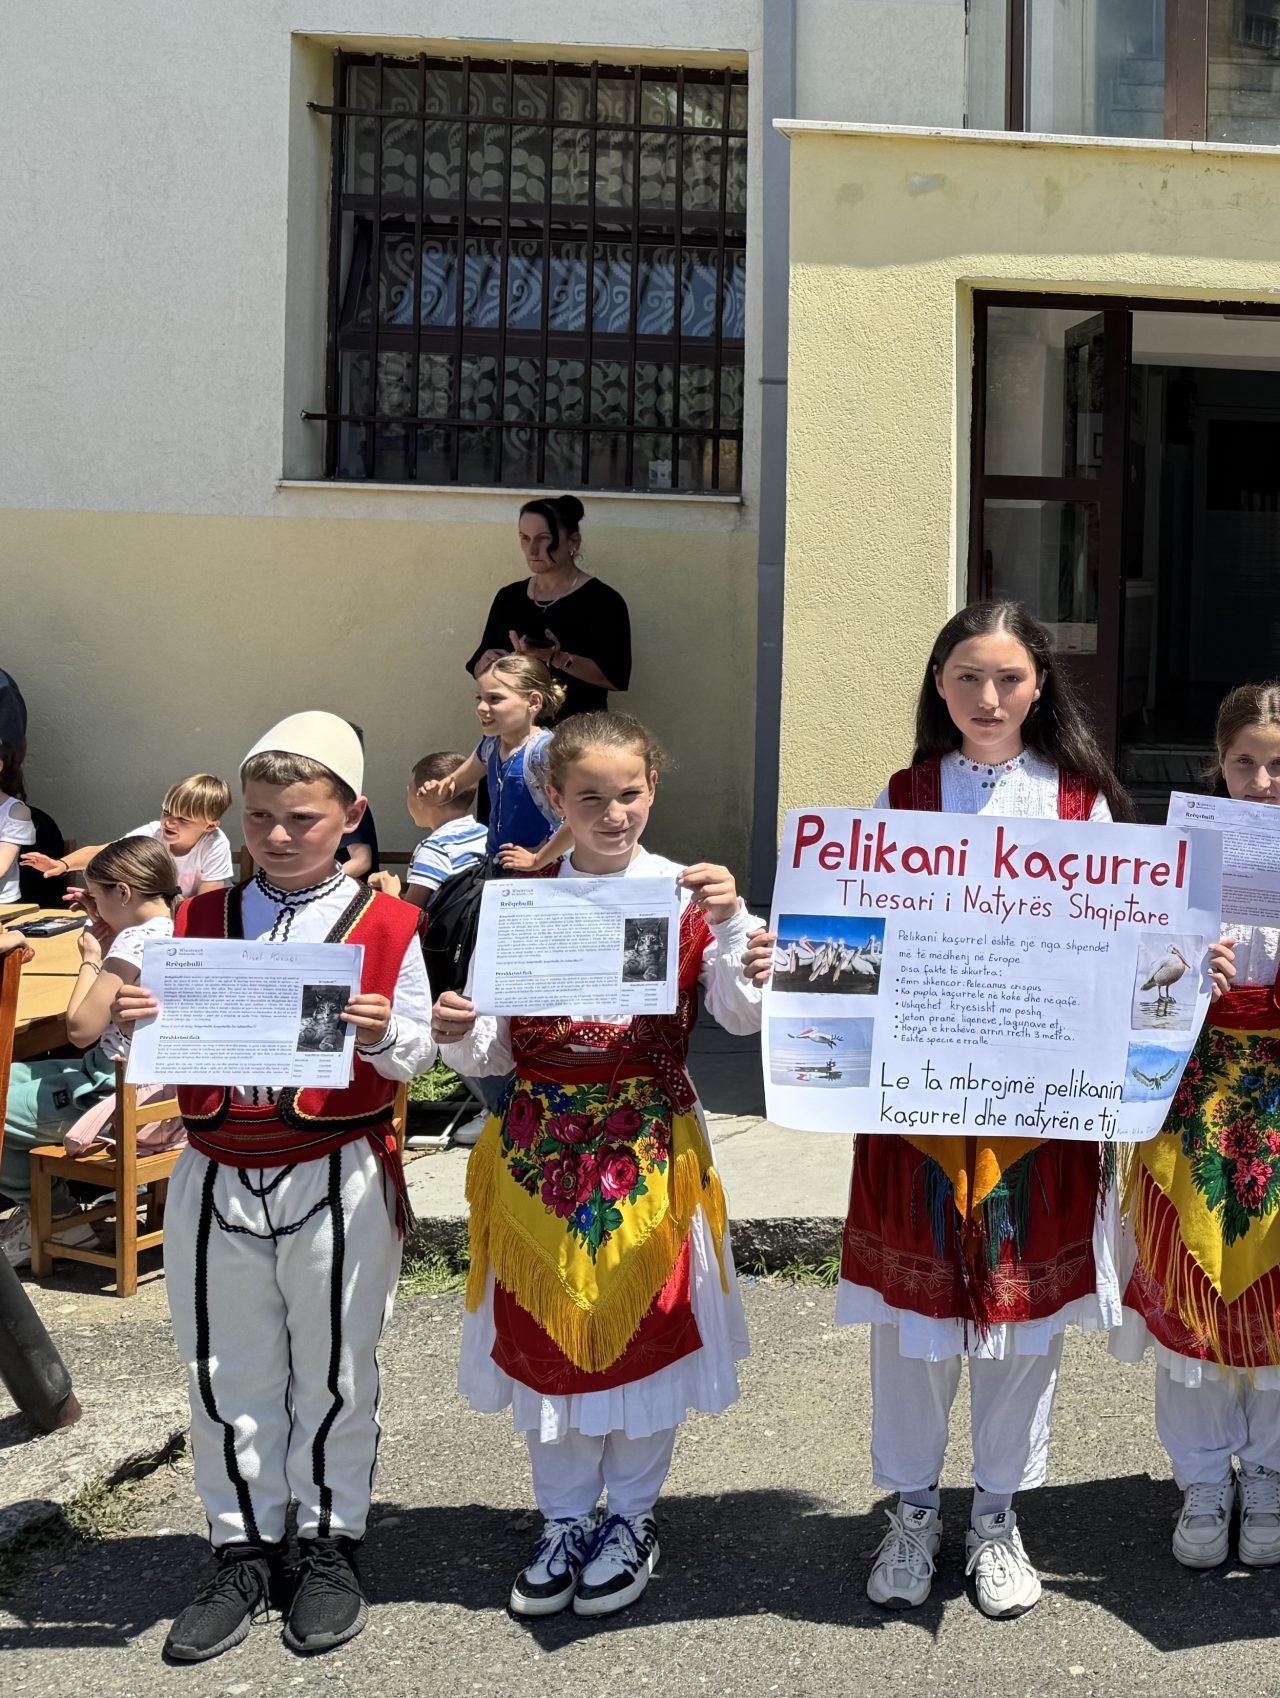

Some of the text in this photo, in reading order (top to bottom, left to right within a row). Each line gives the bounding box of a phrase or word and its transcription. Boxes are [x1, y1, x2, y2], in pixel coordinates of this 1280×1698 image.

[792, 814, 970, 877] Pelikani
[993, 825, 1188, 892] kaçurrel
[836, 878, 1170, 932] Thesari i Natyrës Shqiptare
[898, 929, 938, 943] Pelikani
[942, 932, 987, 946] kaçurrel
[1041, 940, 1061, 953] nga
[923, 964, 947, 976] fakte
[1023, 992, 1041, 1003] dhe
[1034, 1030, 1040, 1039] 3
[880, 1059, 1124, 1105] Le ta mbrojmë pelikanin
[879, 1091, 1120, 1140] kaçurrel dhe natyrën e tij
